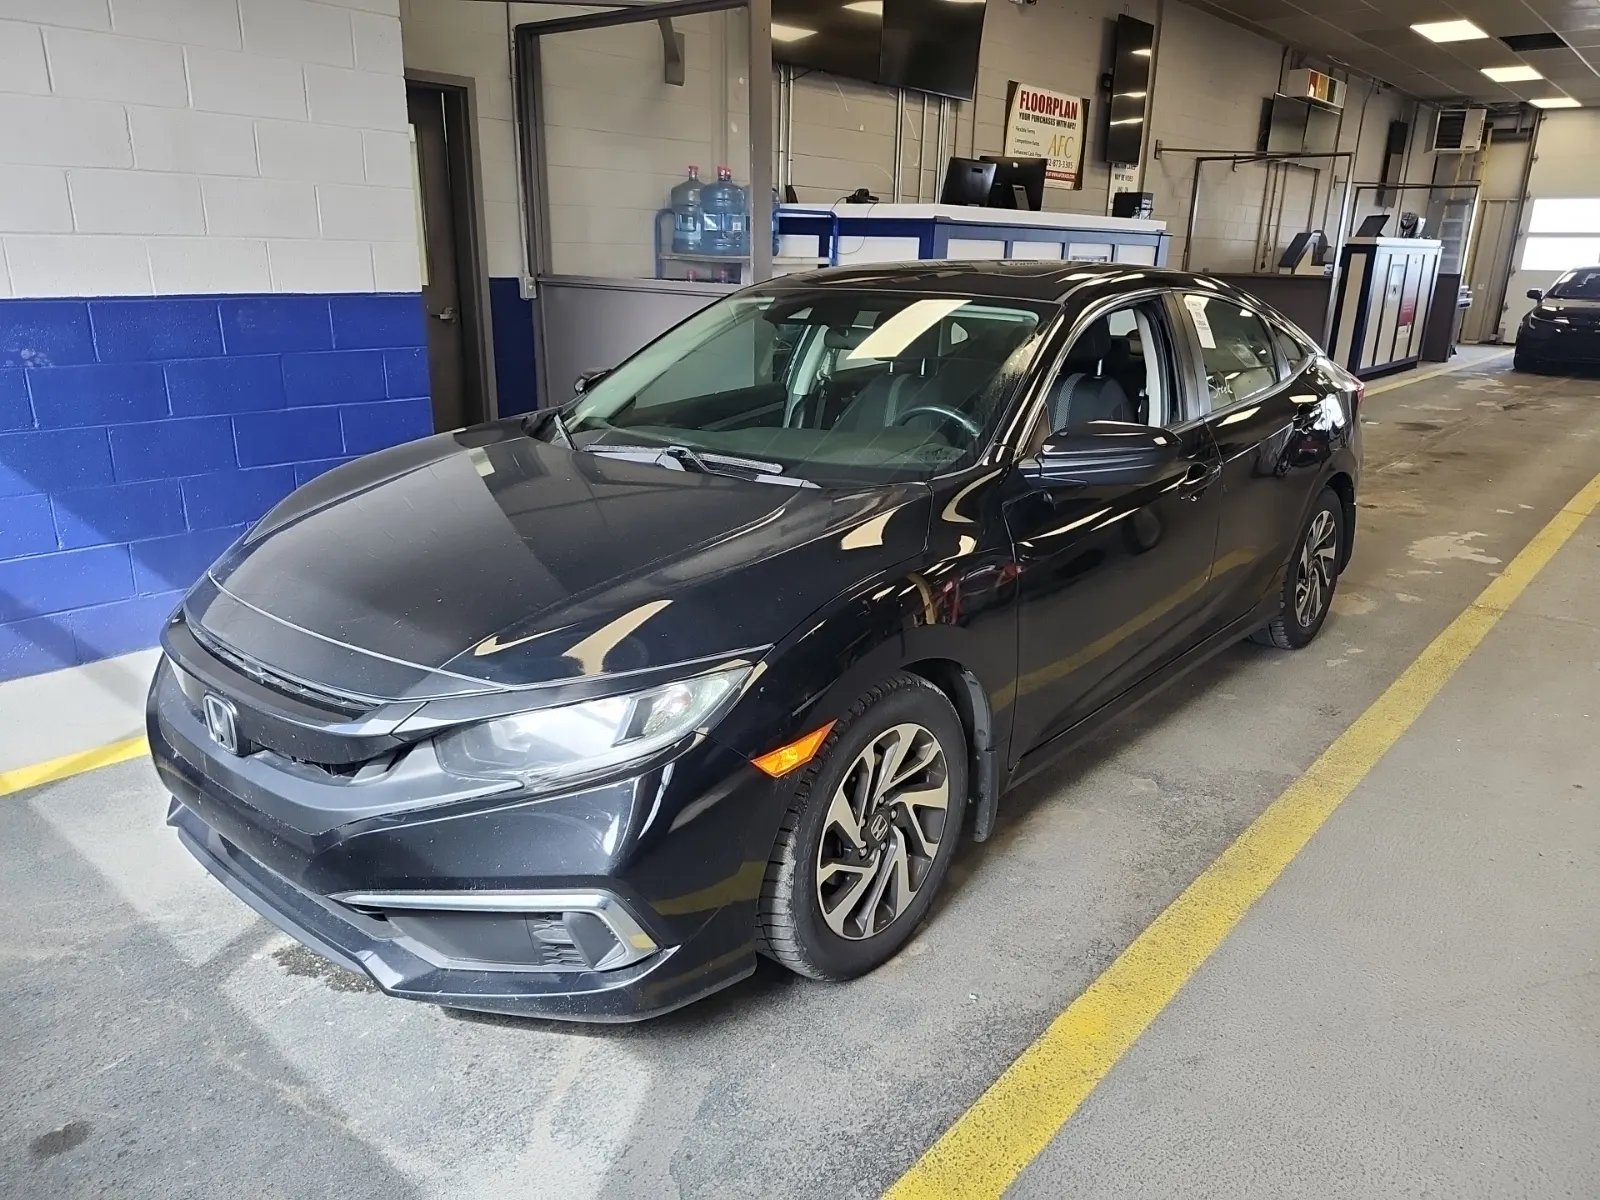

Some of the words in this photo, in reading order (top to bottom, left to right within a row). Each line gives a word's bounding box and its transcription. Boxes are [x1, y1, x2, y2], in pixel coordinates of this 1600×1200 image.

[1020, 90, 1078, 120] FLOORPLAN
[1019, 112, 1031, 121] YOUR
[1031, 114, 1056, 127] PURCHASES
[1056, 119, 1067, 128] WITH
[1048, 133, 1075, 158] AFC
[1047, 159, 1073, 169] 2-873-3305
